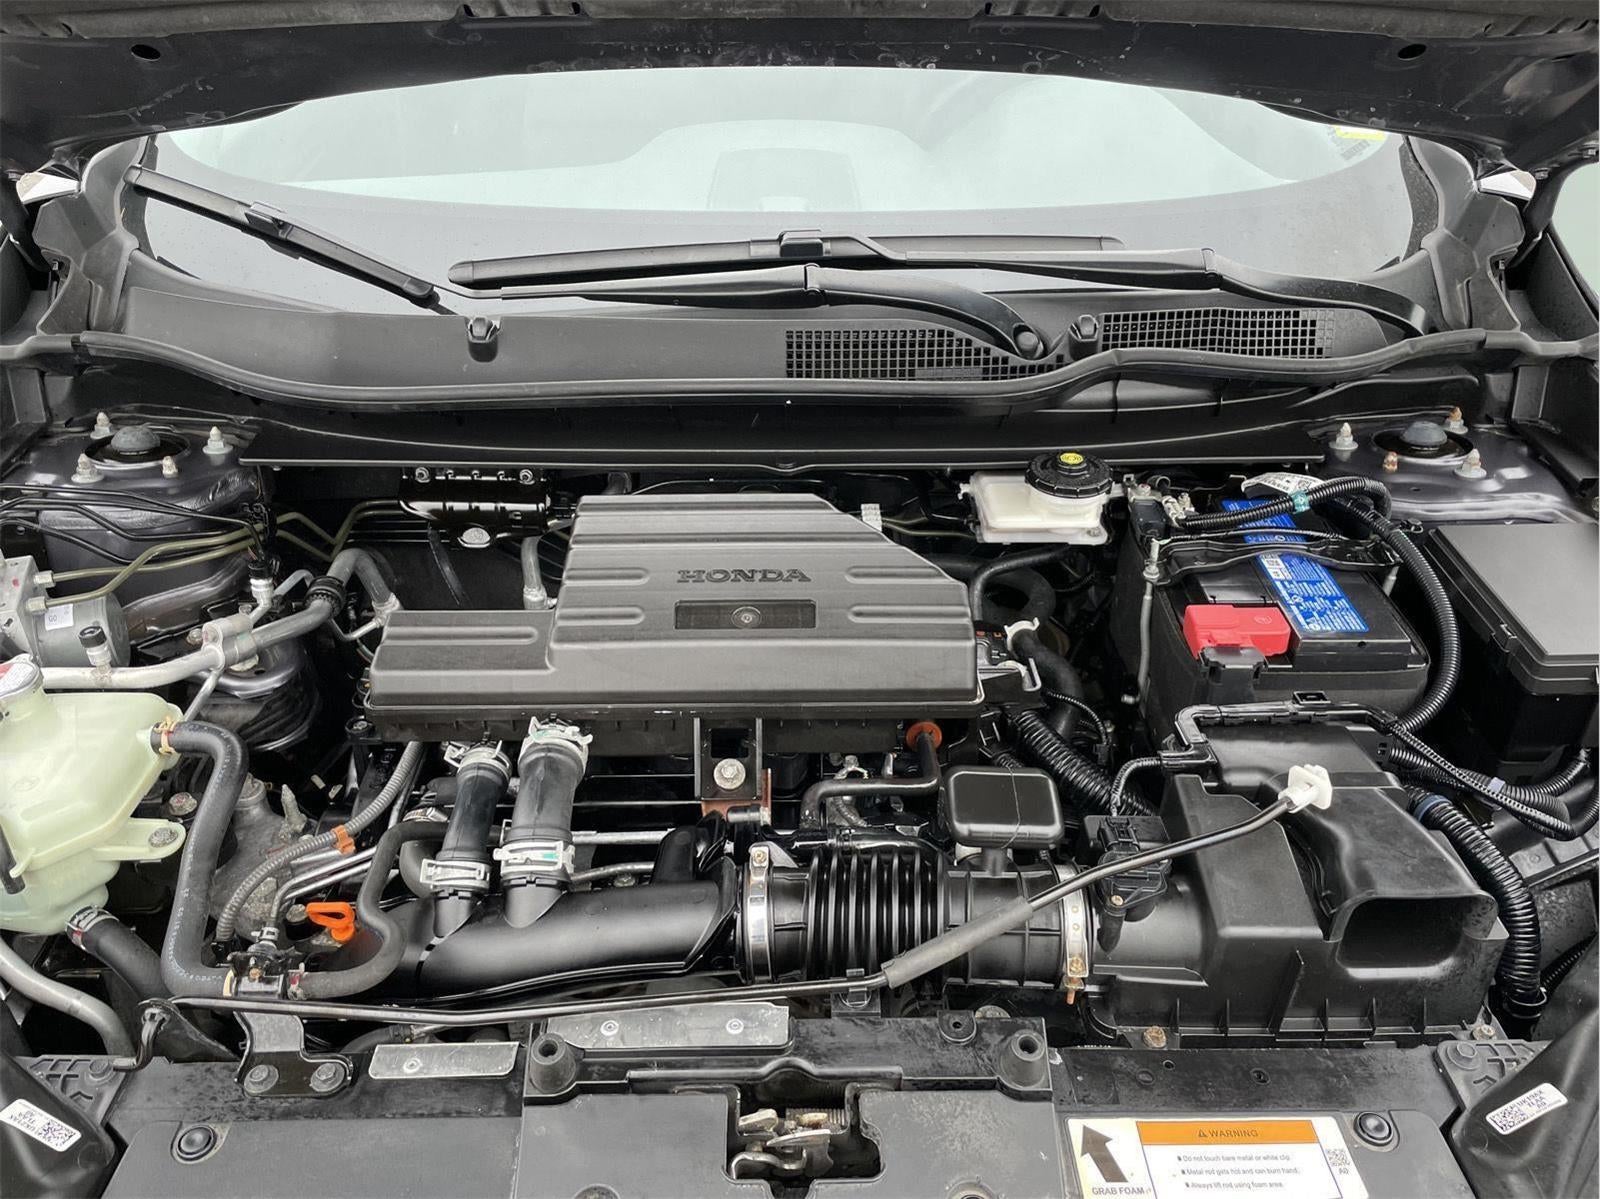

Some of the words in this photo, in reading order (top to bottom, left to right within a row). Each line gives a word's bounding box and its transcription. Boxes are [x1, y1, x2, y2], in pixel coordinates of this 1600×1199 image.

[677, 569, 812, 583] HONDA
[1209, 1129, 1259, 1137] WARNING
[1191, 1182, 1213, 1190] Always
[1092, 1187, 1118, 1196] GRAB
[1119, 1186, 1145, 1195] FOAM
